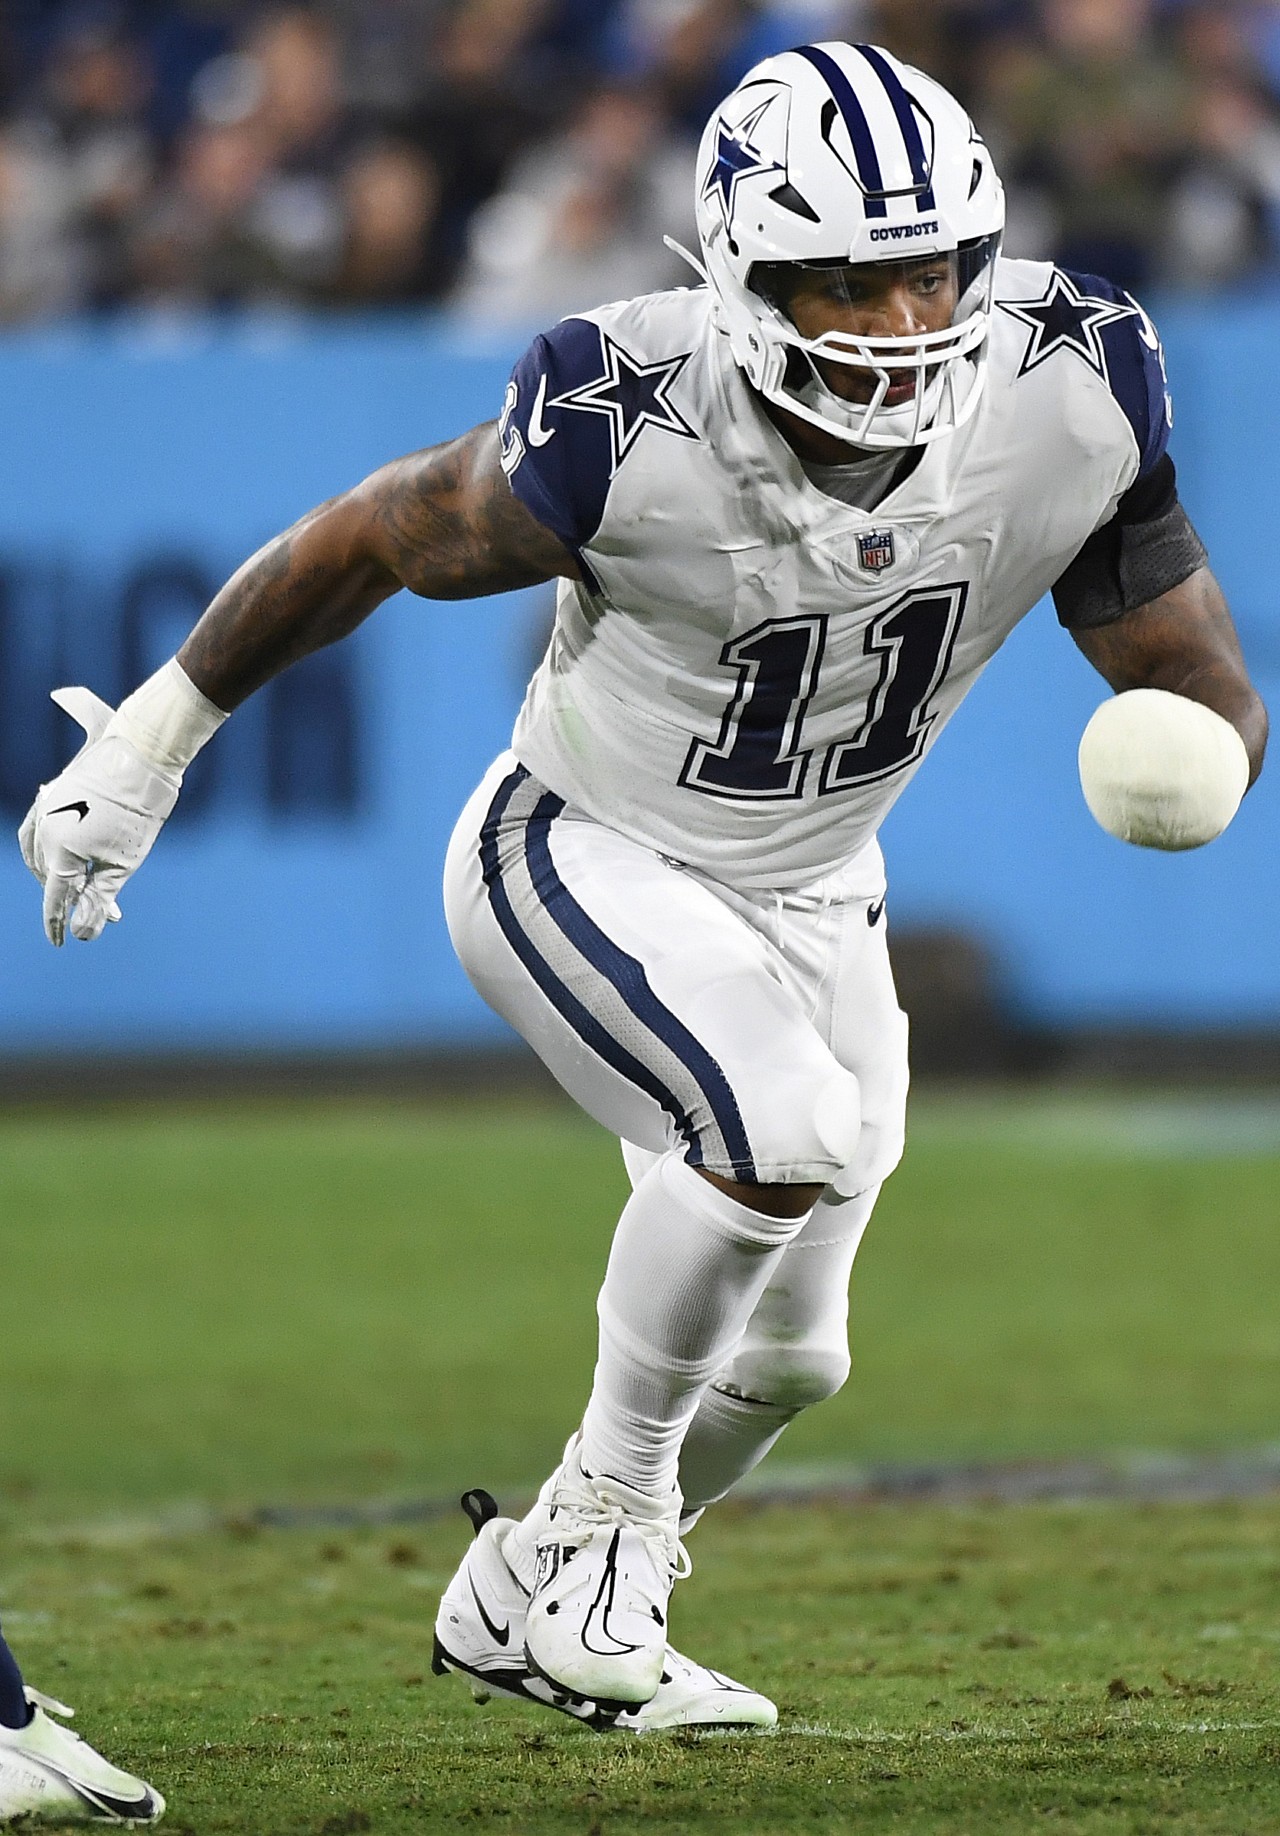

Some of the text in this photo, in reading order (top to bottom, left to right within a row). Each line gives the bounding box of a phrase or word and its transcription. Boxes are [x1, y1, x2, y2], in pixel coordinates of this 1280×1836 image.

[869, 221, 939, 242] COWBOYS
[864, 547, 891, 568] NFL
[676, 580, 970, 801] 11
